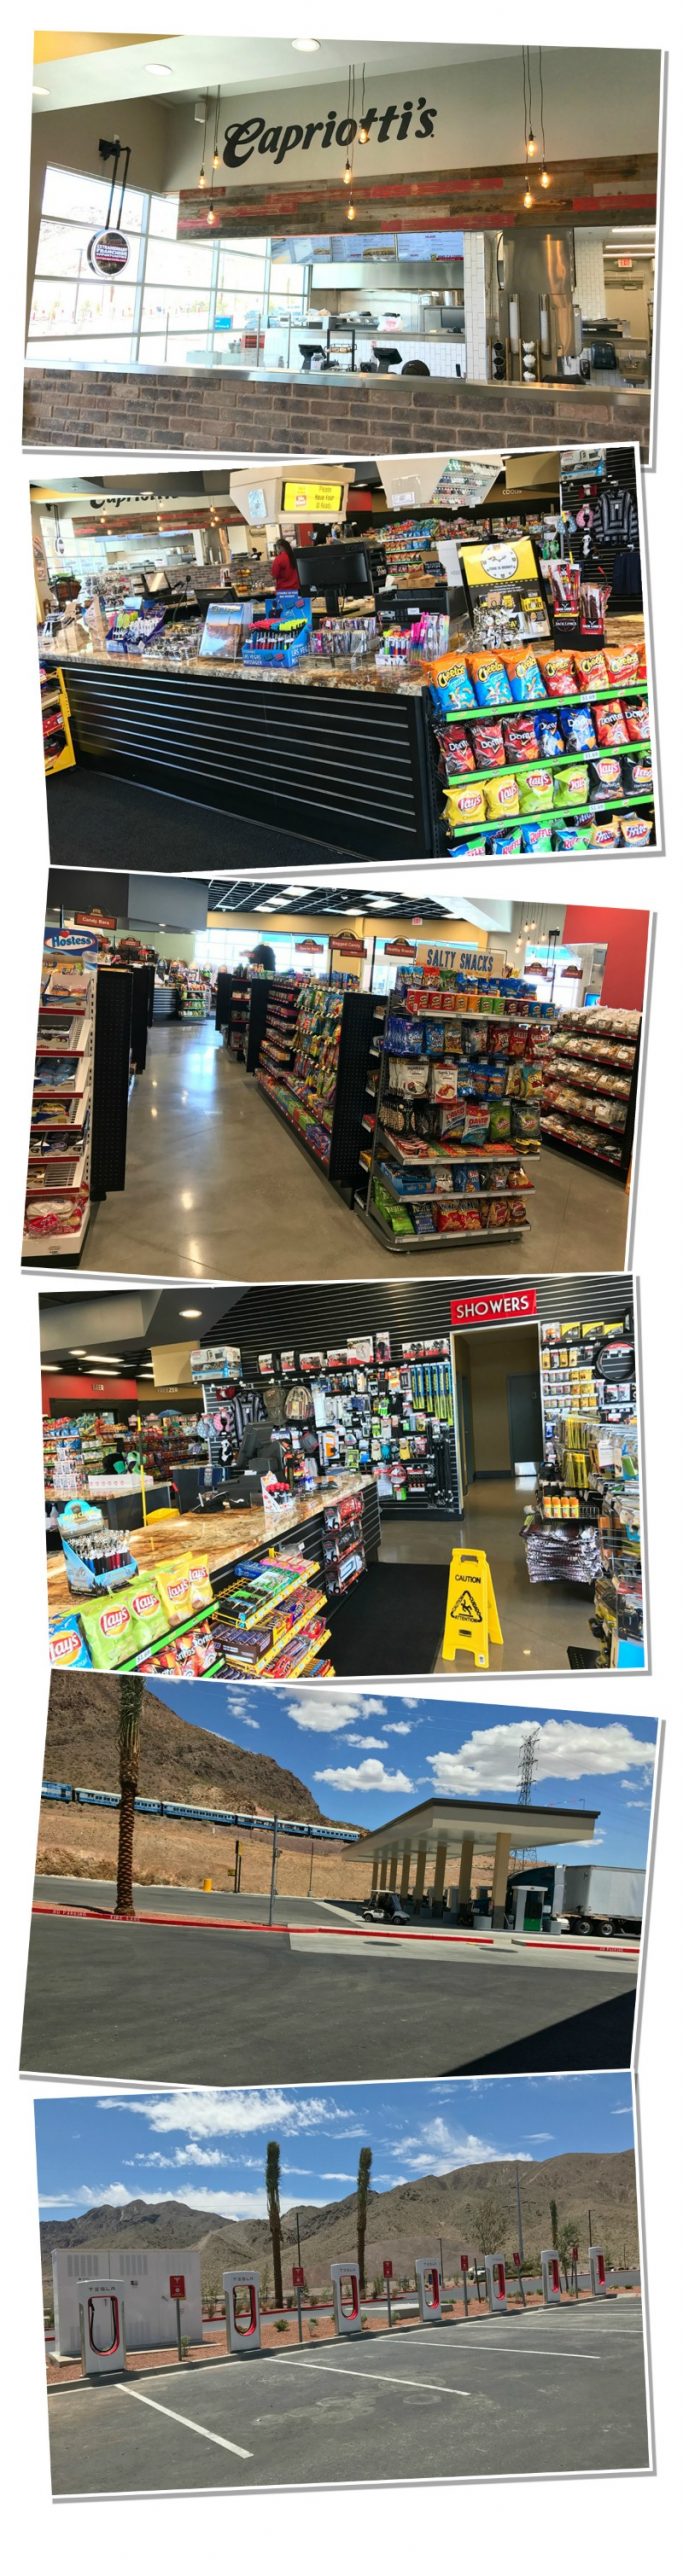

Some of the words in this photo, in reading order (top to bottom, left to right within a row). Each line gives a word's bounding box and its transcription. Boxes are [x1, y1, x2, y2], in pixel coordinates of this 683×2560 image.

[223, 97, 438, 168] Capriotti's
[52, 936, 92, 948] Hostess
[427, 949, 456, 966] SALTY
[460, 953, 494, 972] SNACKS
[456, 1296, 529, 1318] SHOWERS
[454, 1575, 481, 1584] CAUTION
[168, 1580, 189, 1600] Lay's
[132, 1594, 160, 1612] Lay's
[100, 1608, 130, 1628] Lay's
